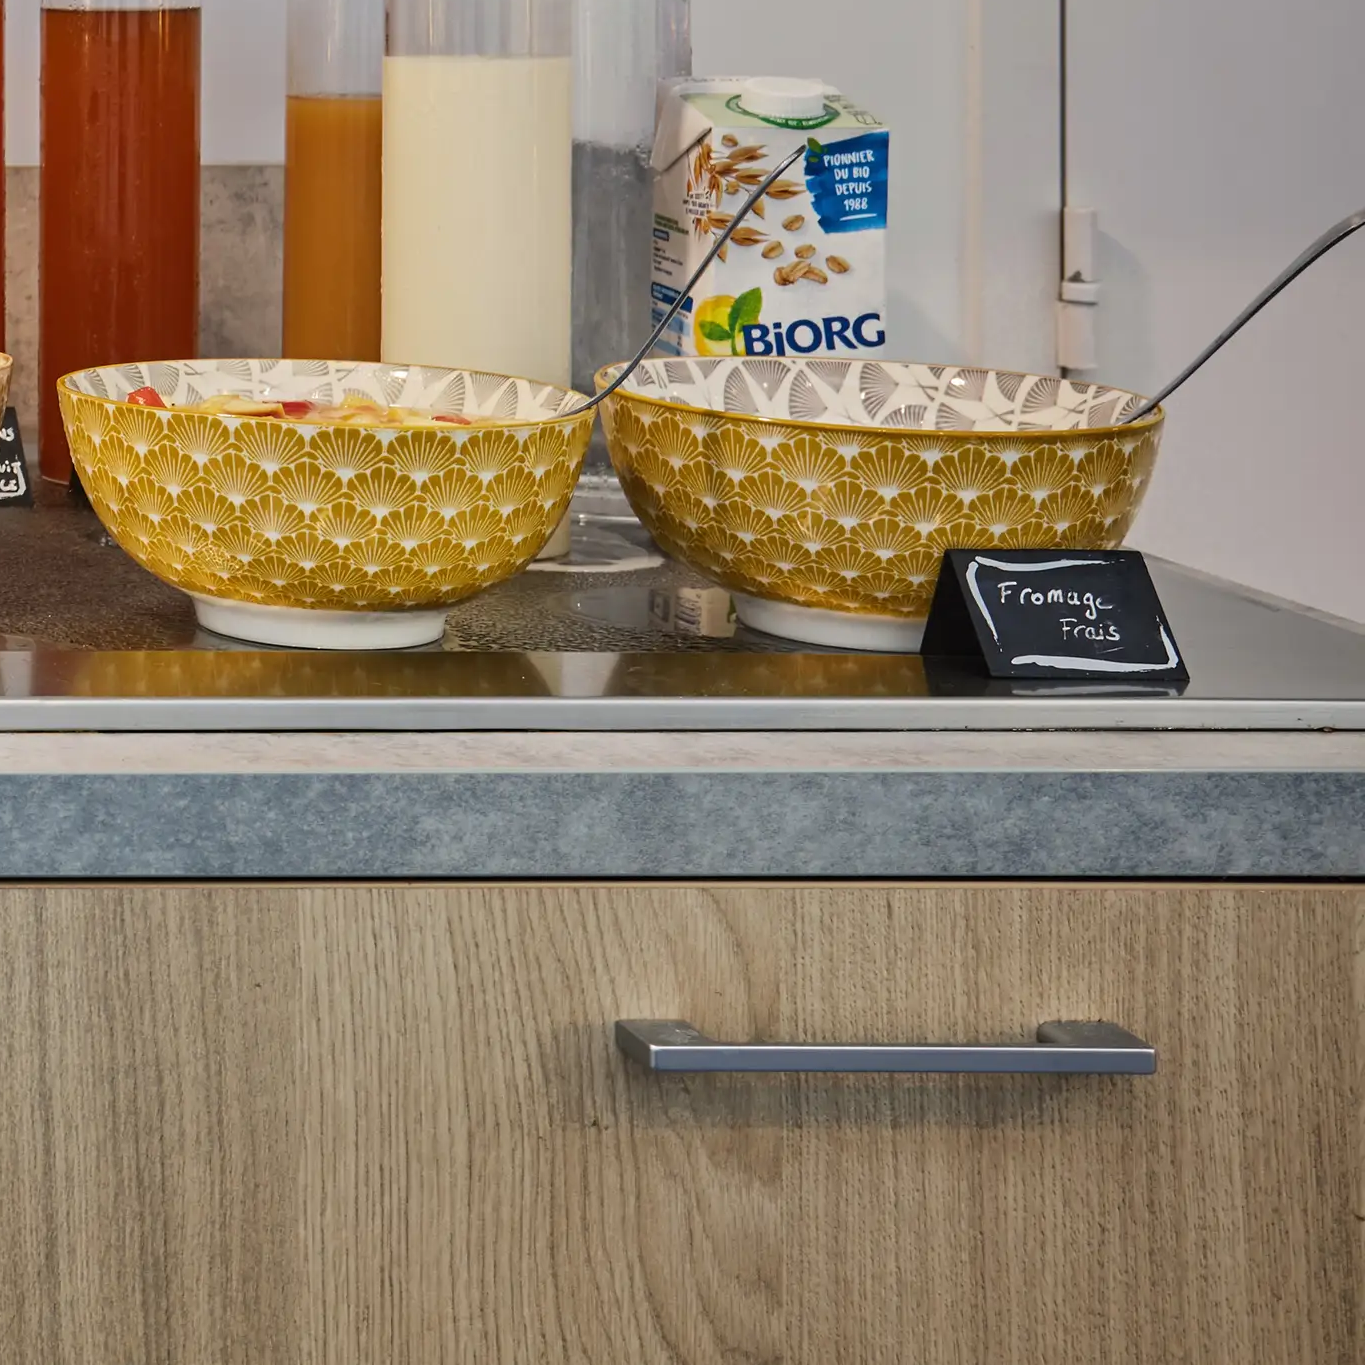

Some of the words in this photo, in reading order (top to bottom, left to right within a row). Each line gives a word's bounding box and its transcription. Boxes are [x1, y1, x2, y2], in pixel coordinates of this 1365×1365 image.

[823, 150, 875, 167] PIONNIER
[834, 168, 849, 181] DU
[852, 167, 870, 180] BIO
[835, 181, 872, 196] DEPUIS
[843, 197, 868, 212] 1988
[997, 581, 1114, 621] Fromage
[1059, 618, 1121, 642] Frais
